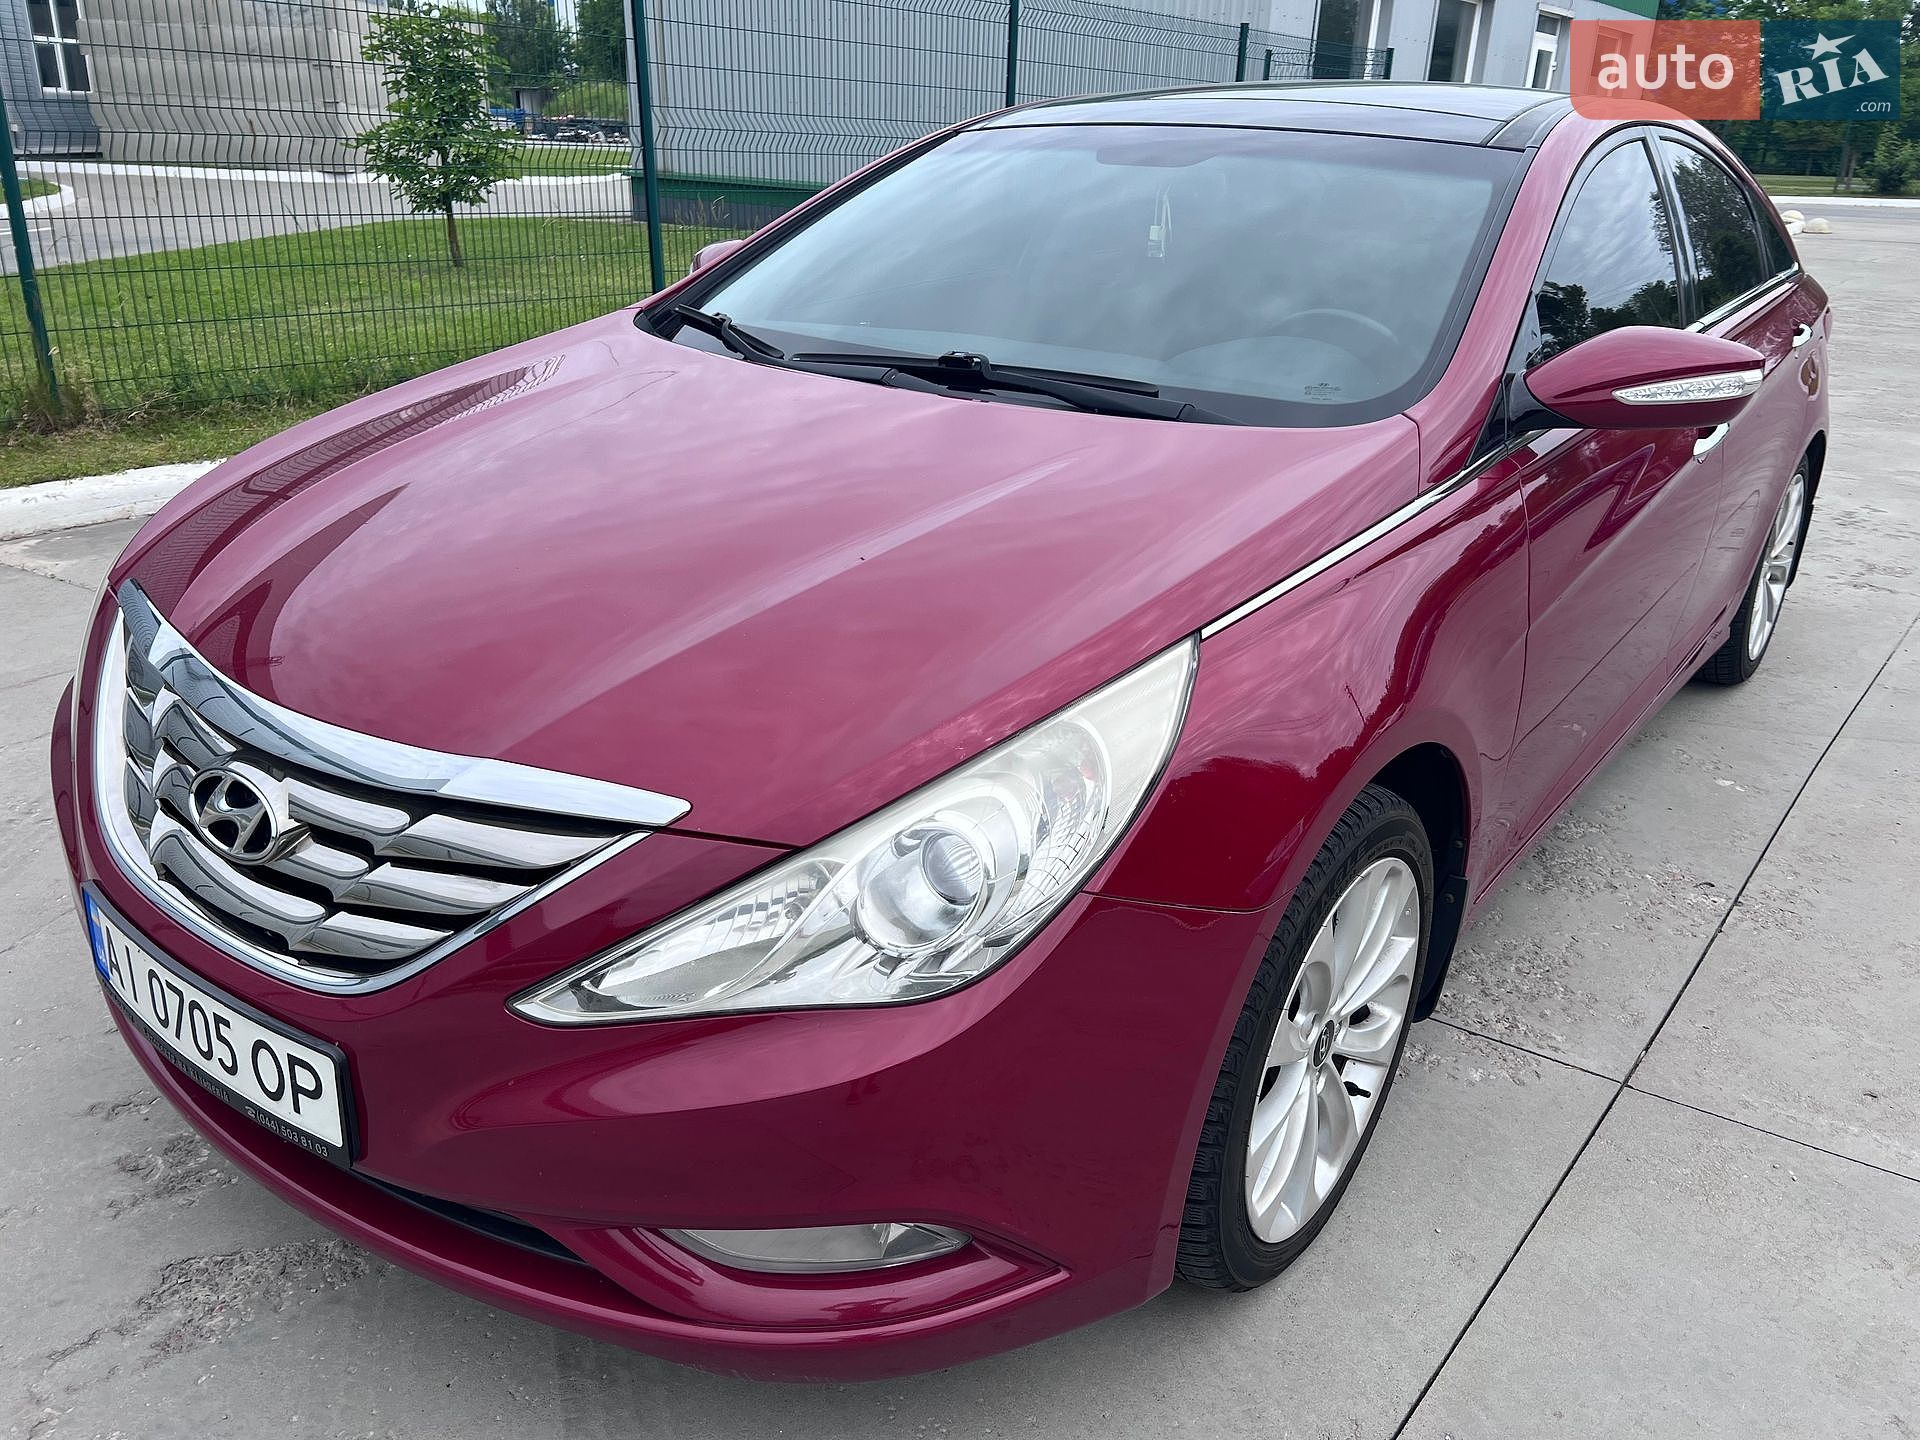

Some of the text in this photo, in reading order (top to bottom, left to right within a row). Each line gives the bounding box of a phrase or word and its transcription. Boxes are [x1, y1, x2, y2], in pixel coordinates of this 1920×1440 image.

[105, 925, 139, 1004] AI
[147, 968, 239, 1077] 0705
[251, 1038, 324, 1115] OP
[256, 1110, 329, 1157] (044) 503 81 03
